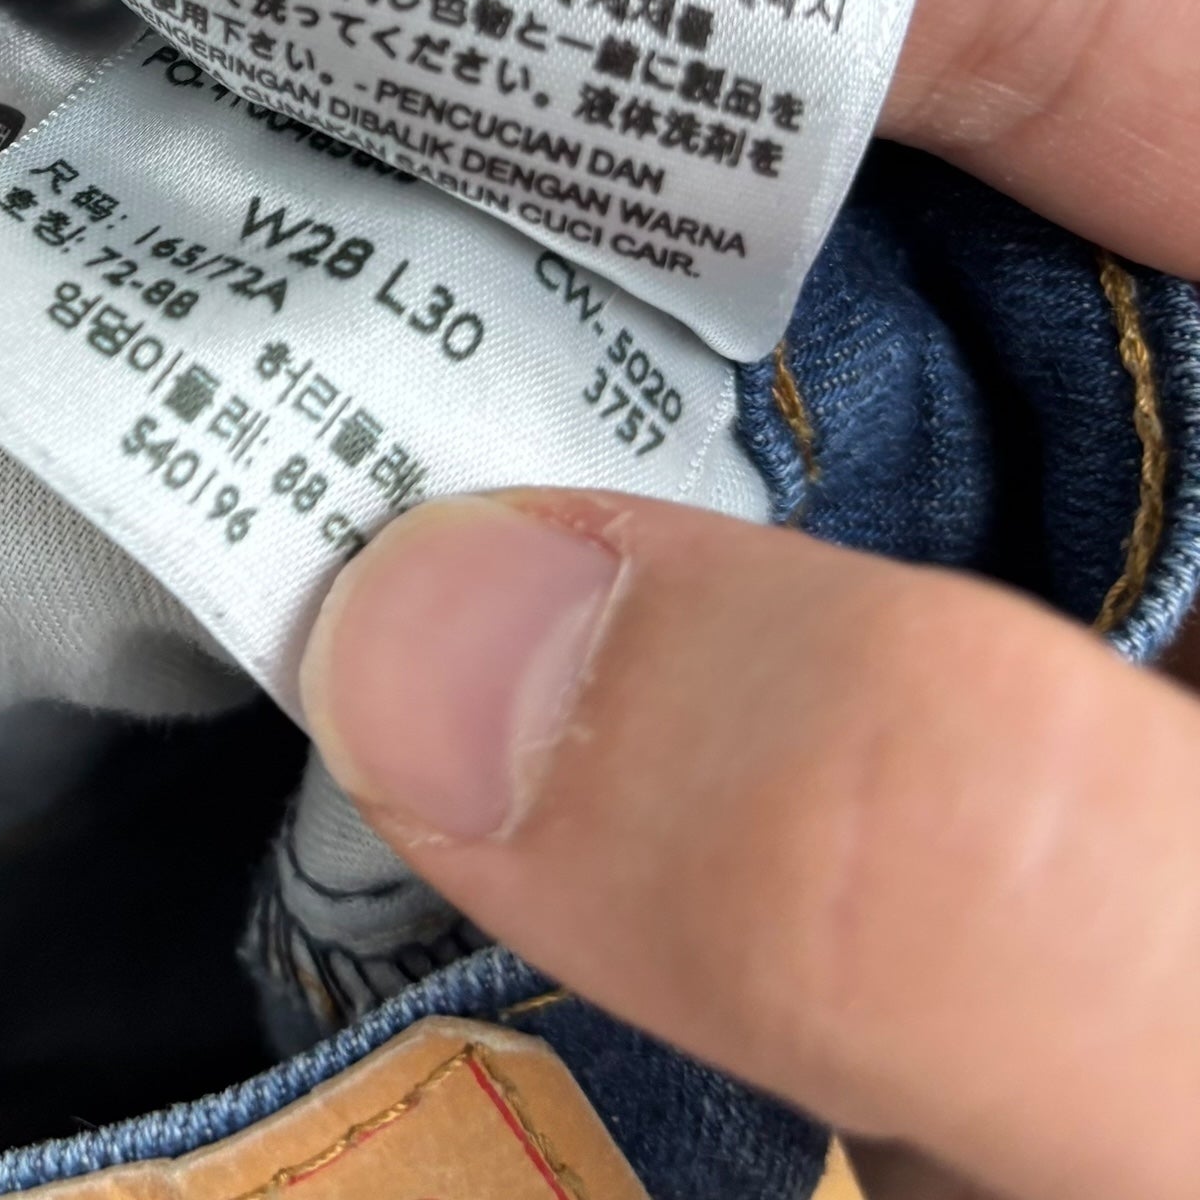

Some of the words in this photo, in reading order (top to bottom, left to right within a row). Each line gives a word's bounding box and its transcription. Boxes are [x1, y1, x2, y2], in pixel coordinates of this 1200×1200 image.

[328, 96, 456, 165] DIBALIK
[460, 146, 612, 218] DENGAN
[619, 196, 747, 260] WARNA
[373, 77, 582, 169] PENCUCIAN
[587, 147, 665, 196] DAN
[132, 224, 288, 315] 165/72A
[395, 152, 510, 213] SABUN
[517, 201, 602, 248] CUCI
[609, 233, 701, 278] CAIR.
[83, 245, 200, 320] 72-88
[239, 196, 376, 280] W28
[374, 258, 485, 362] L30
[583, 366, 666, 458] 3757
[121, 415, 259, 545] S40196
[271, 454, 329, 513] 88
